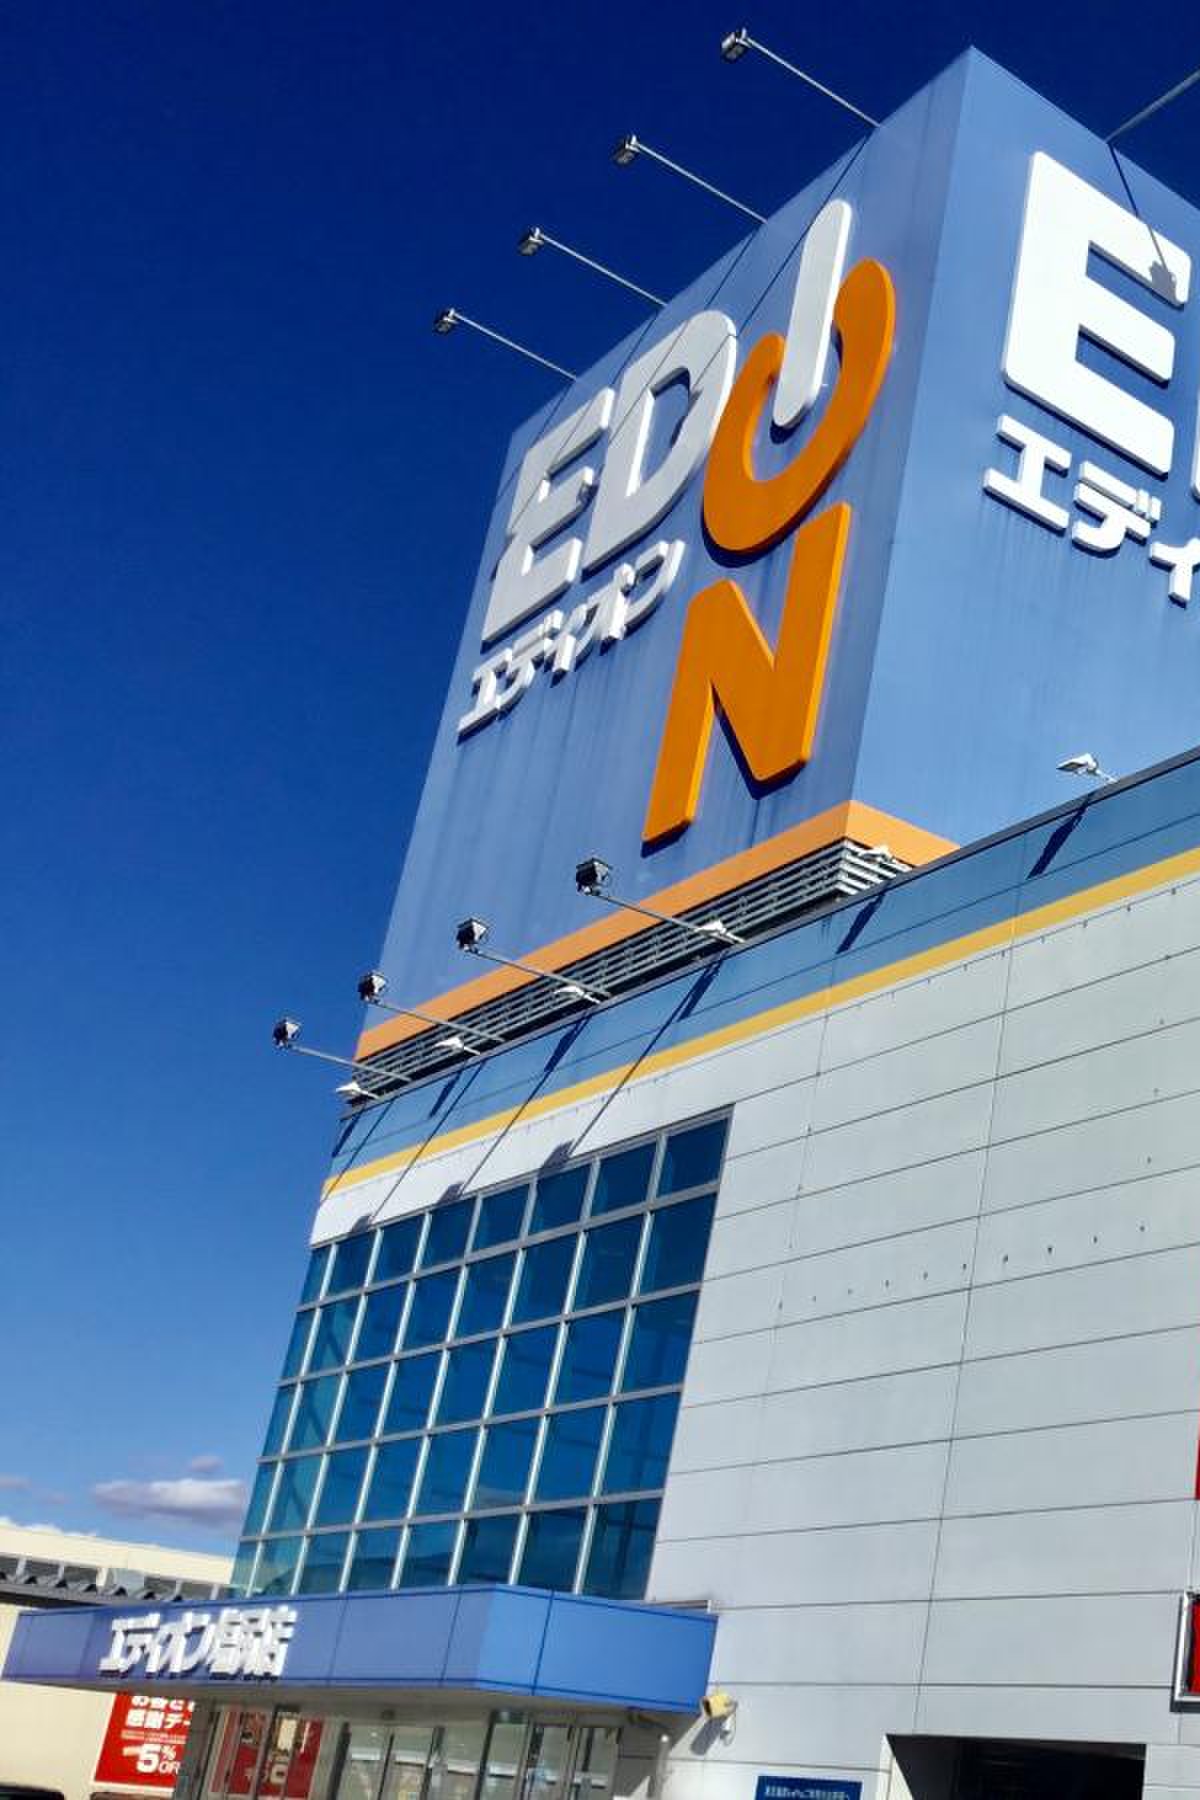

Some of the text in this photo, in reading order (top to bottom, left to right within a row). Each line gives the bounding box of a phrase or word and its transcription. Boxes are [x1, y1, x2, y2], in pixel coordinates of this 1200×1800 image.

[458, 541, 685, 738] エディオン
